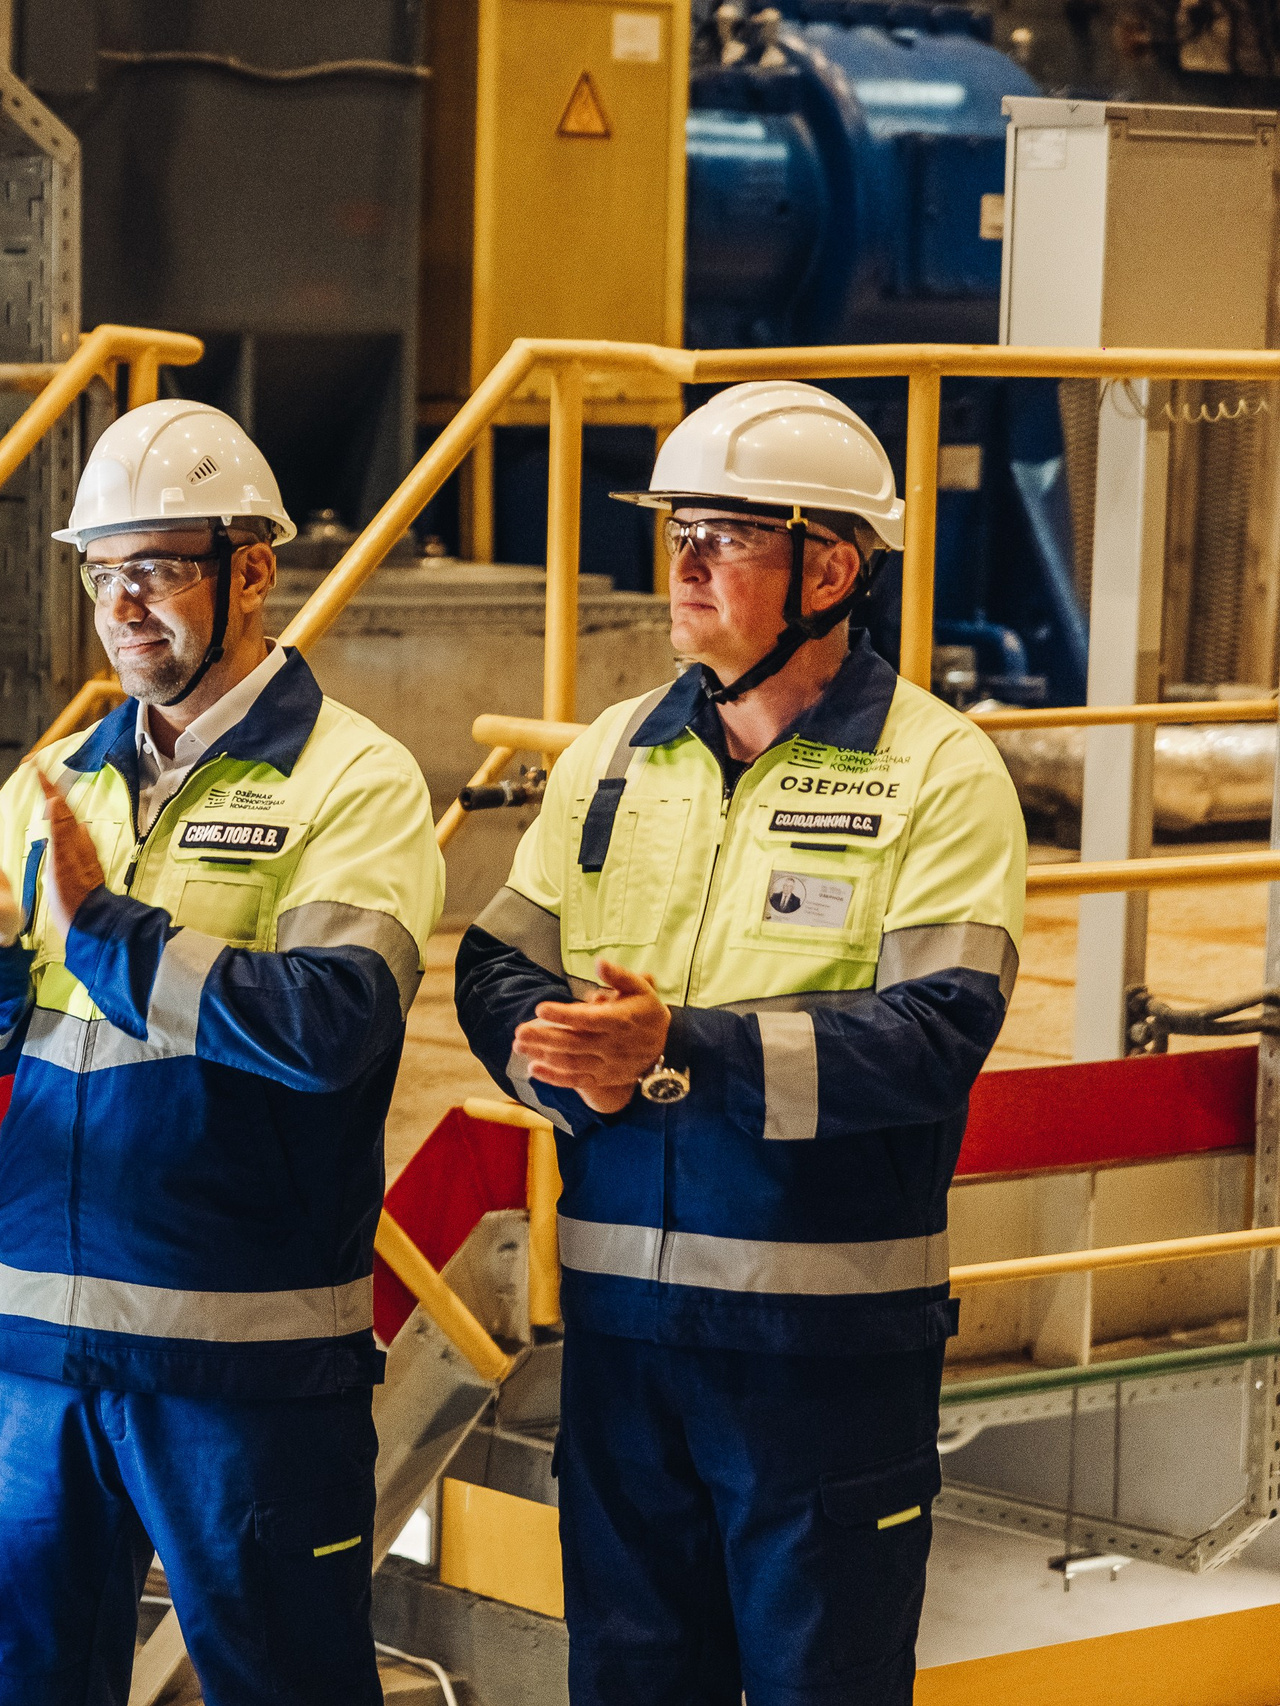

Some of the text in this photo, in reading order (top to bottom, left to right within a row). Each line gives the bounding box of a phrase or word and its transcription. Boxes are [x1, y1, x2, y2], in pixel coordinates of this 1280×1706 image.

[780, 776, 900, 799] ОЗЕРНОЕ
[775, 813, 874, 831] СОЛОДЯНКИН С.С.
[184, 825, 278, 847] СВИБЛОВ В.В.
